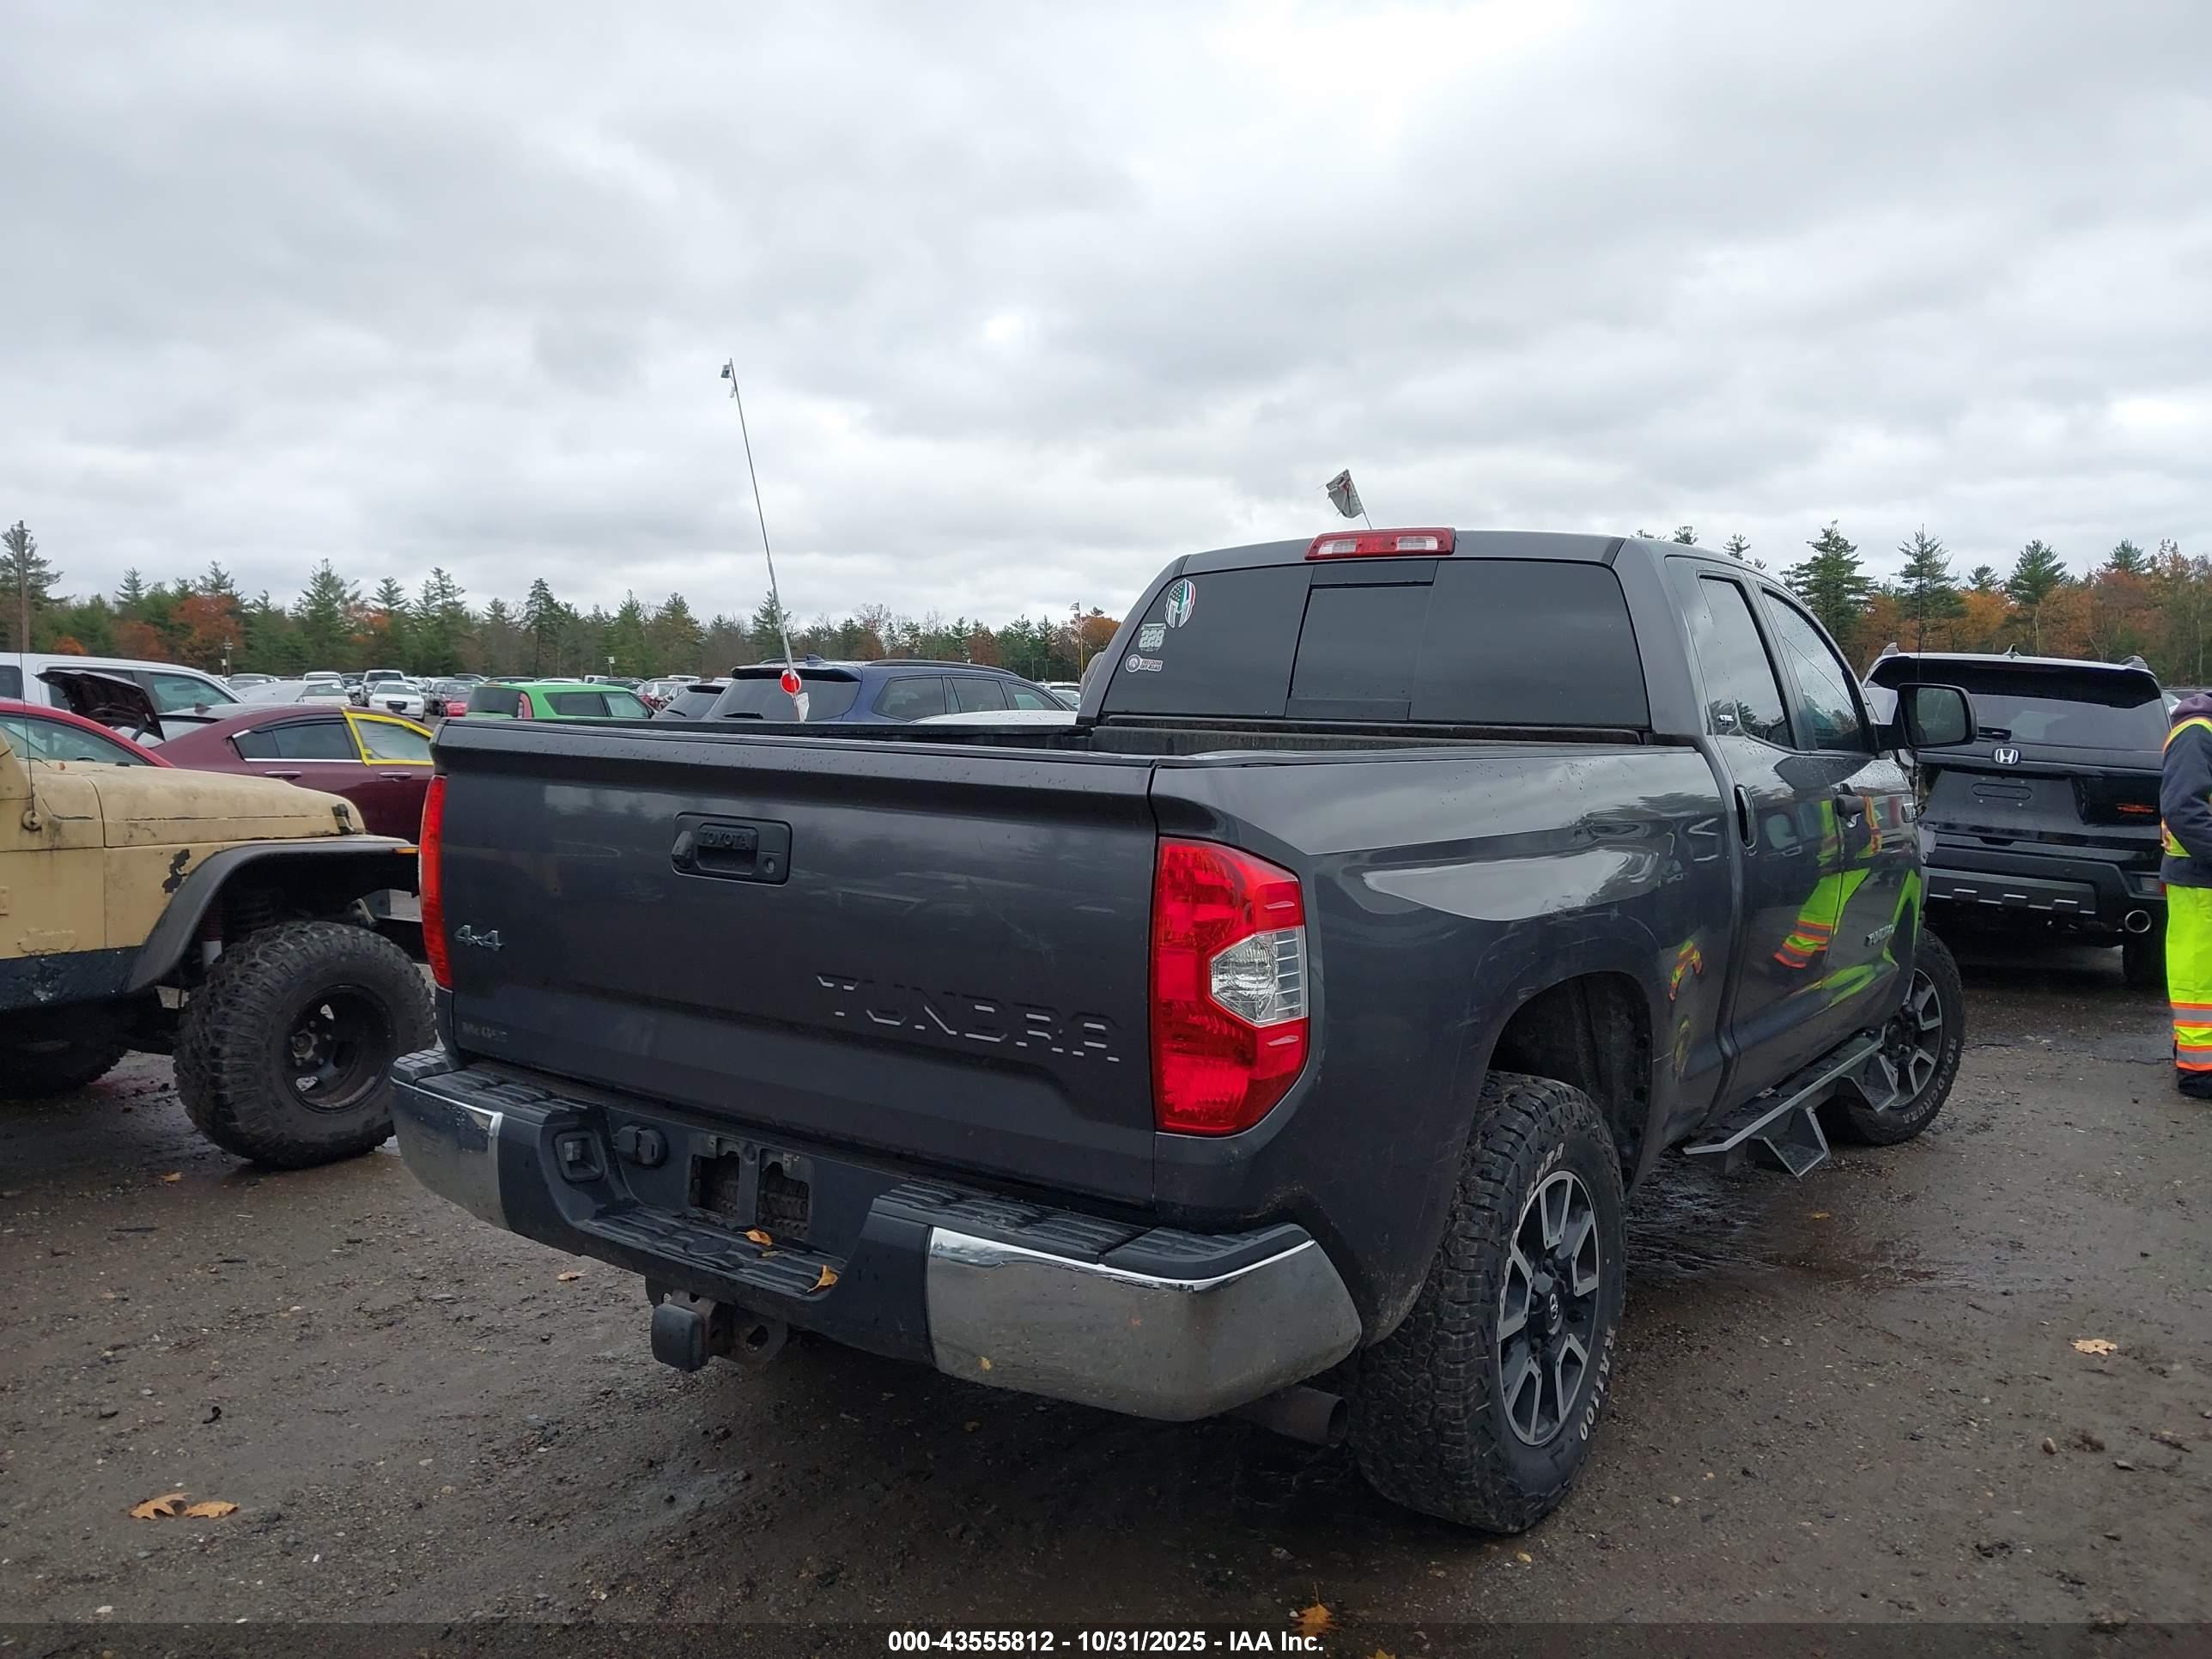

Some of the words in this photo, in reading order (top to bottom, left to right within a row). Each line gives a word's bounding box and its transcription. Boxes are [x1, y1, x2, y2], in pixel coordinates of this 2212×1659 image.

[1139, 629, 1164, 647] 228
[700, 830, 750, 848] TOYOTA
[817, 972, 1120, 1062] TUNDRA
